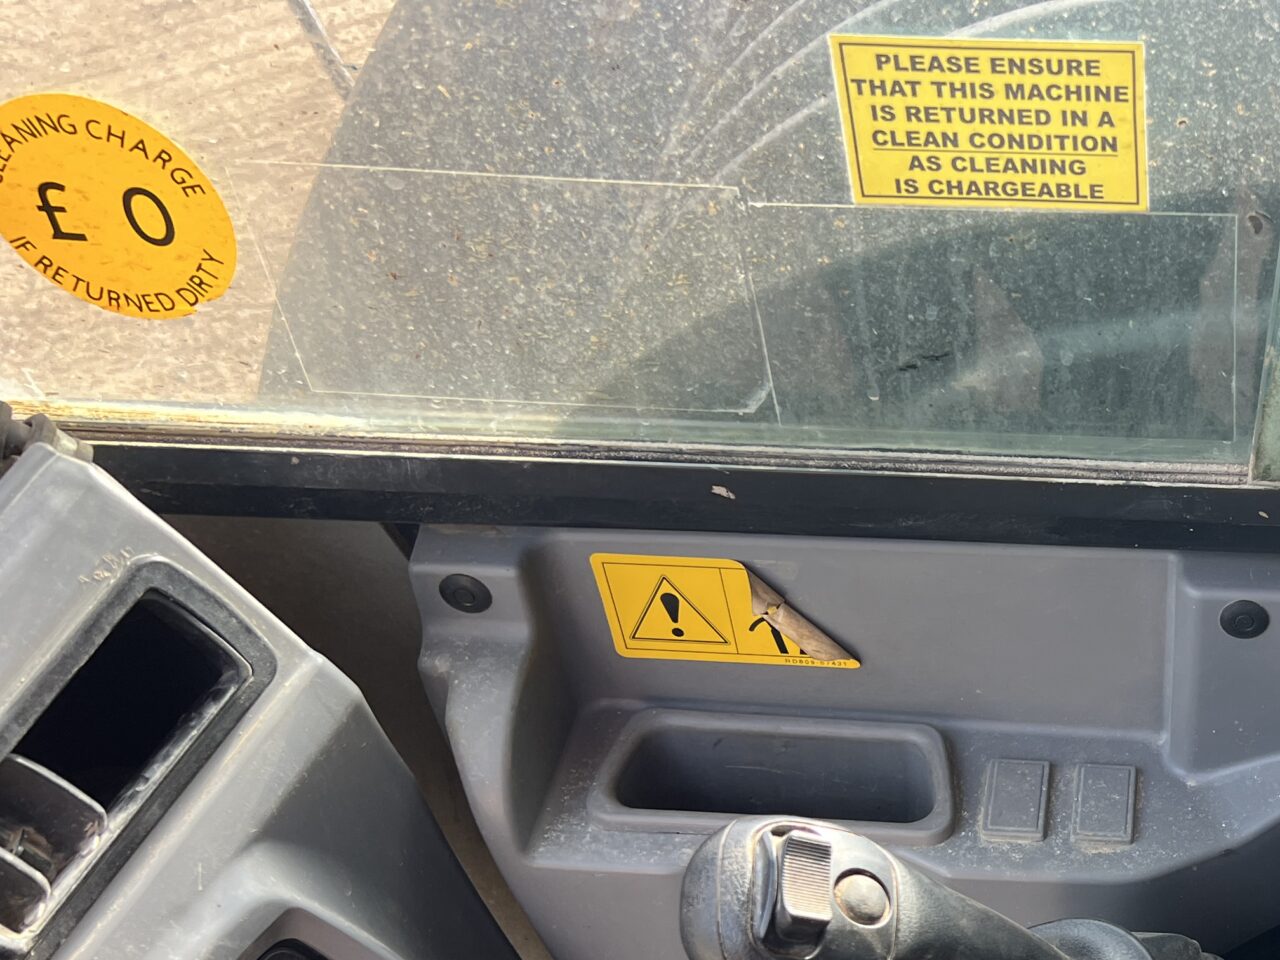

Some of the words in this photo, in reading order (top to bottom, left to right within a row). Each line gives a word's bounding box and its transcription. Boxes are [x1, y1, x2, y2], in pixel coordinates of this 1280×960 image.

[875, 54, 981, 74] PLEASE
[990, 57, 1101, 77] ENSURE
[850, 78, 922, 98] THAT
[930, 82, 996, 100] THIS
[1004, 83, 1130, 104] MACHINE
[871, 104, 896, 122] IS
[905, 106, 1052, 126] RETURNED
[1061, 110, 1088, 128] IN
[1097, 112, 1116, 128] A
[872, 130, 960, 148] CLEAN
[968, 132, 1118, 152] CONDITION
[85, 119, 206, 198] CHARGE
[908, 155, 942, 172] AS
[950, 156, 1087, 176] CLEANING
[894, 178, 920, 195] IS
[928, 180, 1105, 200] CHARGEABLE
[36, 181, 88, 242] £
[9, 236, 38, 252] IF
[34, 254, 176, 312] RETURNED
[176, 248, 224, 307] DIRTY
